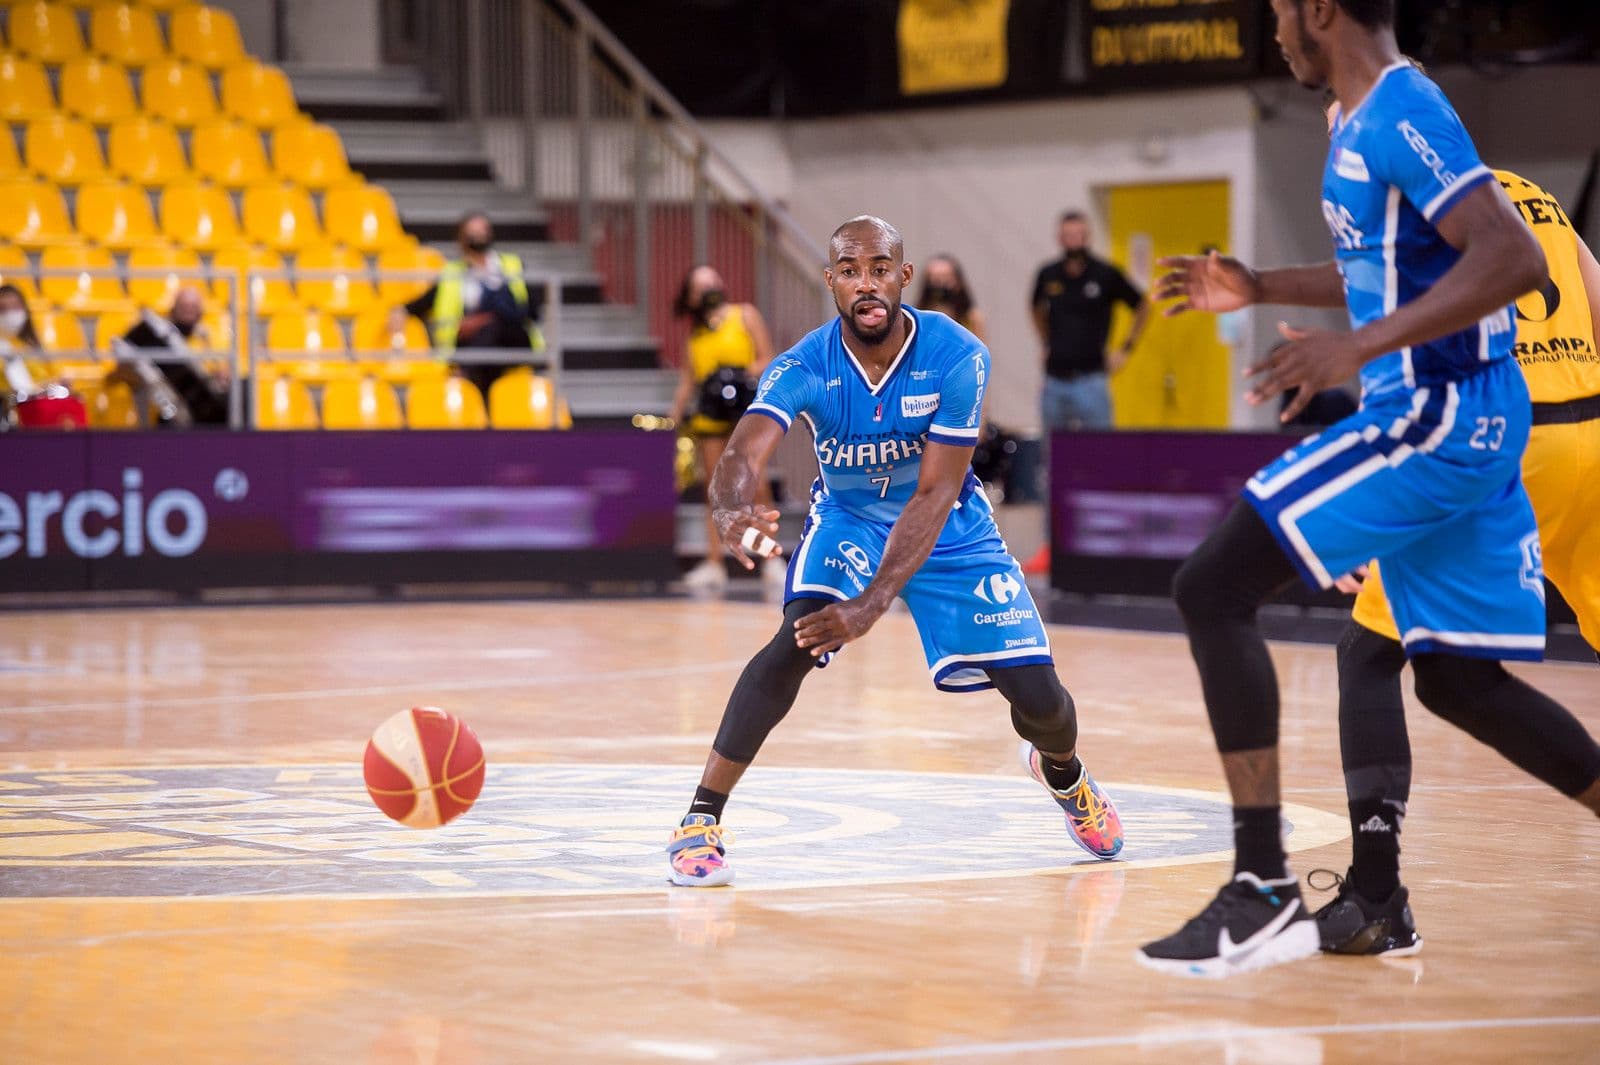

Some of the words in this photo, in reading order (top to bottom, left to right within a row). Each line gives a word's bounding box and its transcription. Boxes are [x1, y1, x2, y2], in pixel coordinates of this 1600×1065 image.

[1469, 416, 1507, 451] 23
[870, 475, 893, 498] 7
[973, 607, 1034, 625] Carrefour
[1004, 636, 1038, 649] SPALDING
